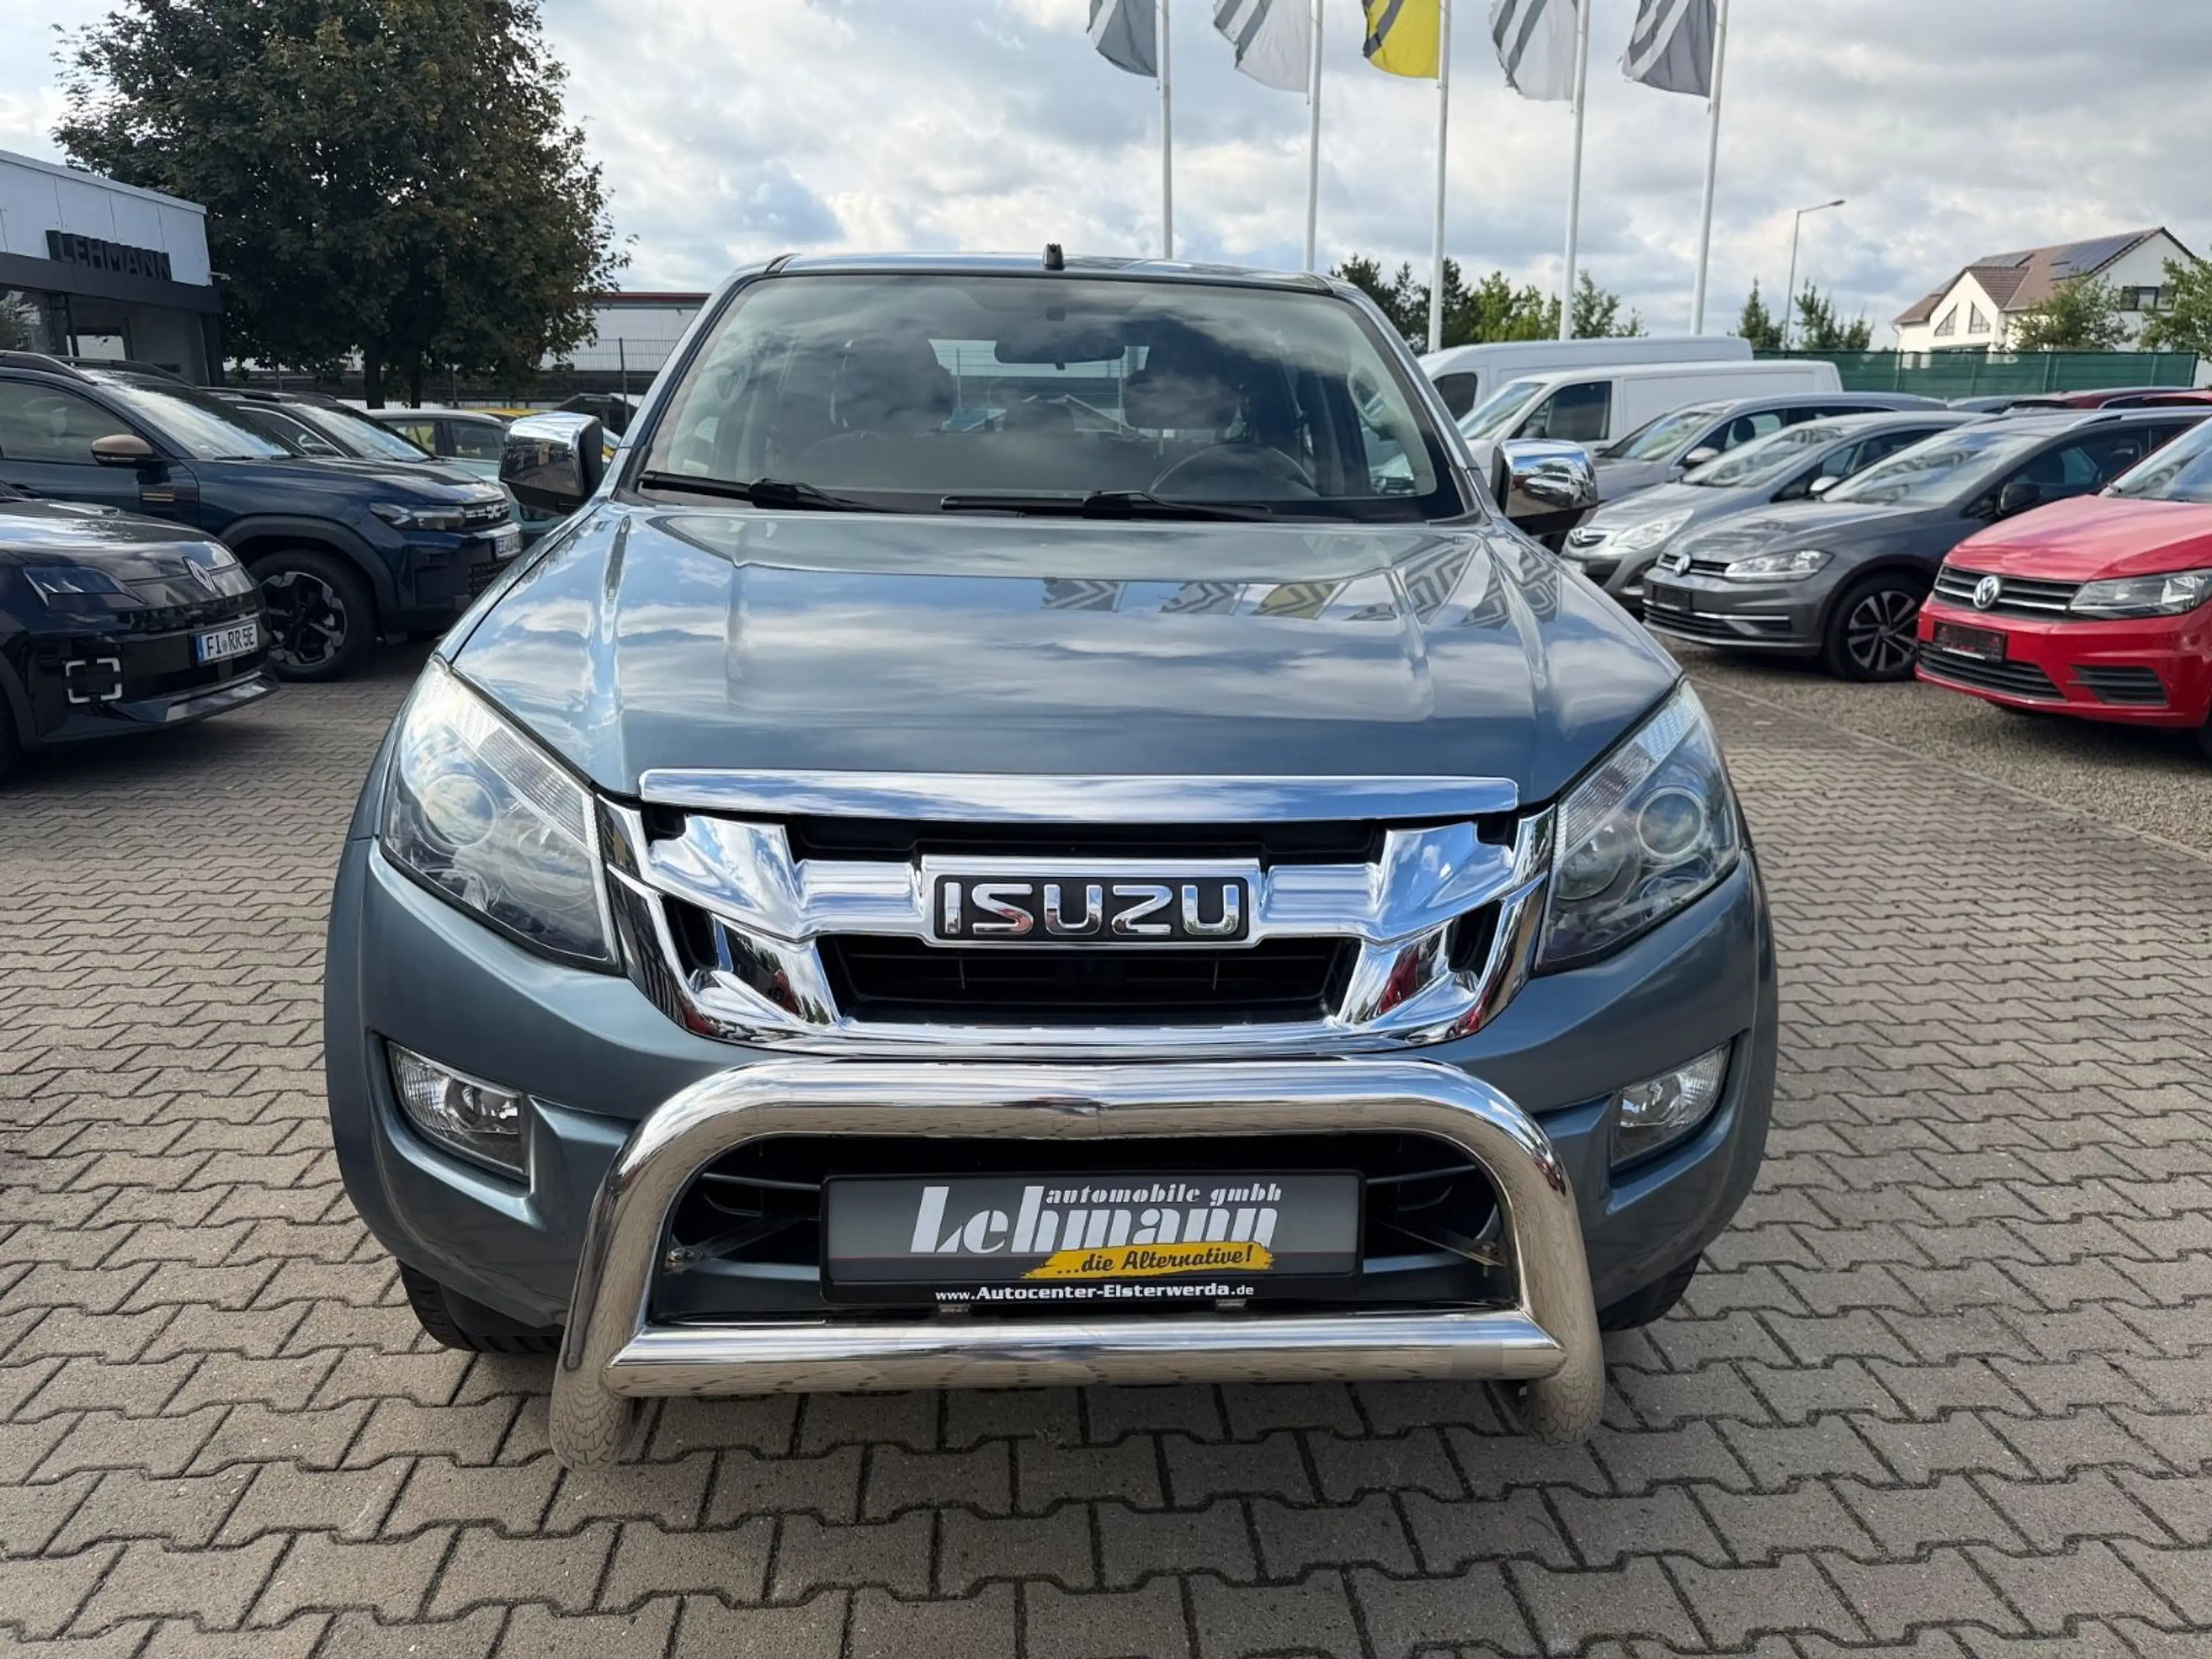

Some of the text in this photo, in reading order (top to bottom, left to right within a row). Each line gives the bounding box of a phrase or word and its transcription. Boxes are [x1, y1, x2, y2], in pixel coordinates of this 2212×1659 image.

[46, 230, 172, 281] LEHMANN
[944, 881, 1239, 935] ISUZU
[1046, 1183, 1282, 1206] automobile gmbh
[910, 1185, 1278, 1253] Lehmann
[1121, 1244, 1253, 1270] Alternative!
[934, 1283, 1255, 1300] www.Autocenter-Elsterwerda.de
